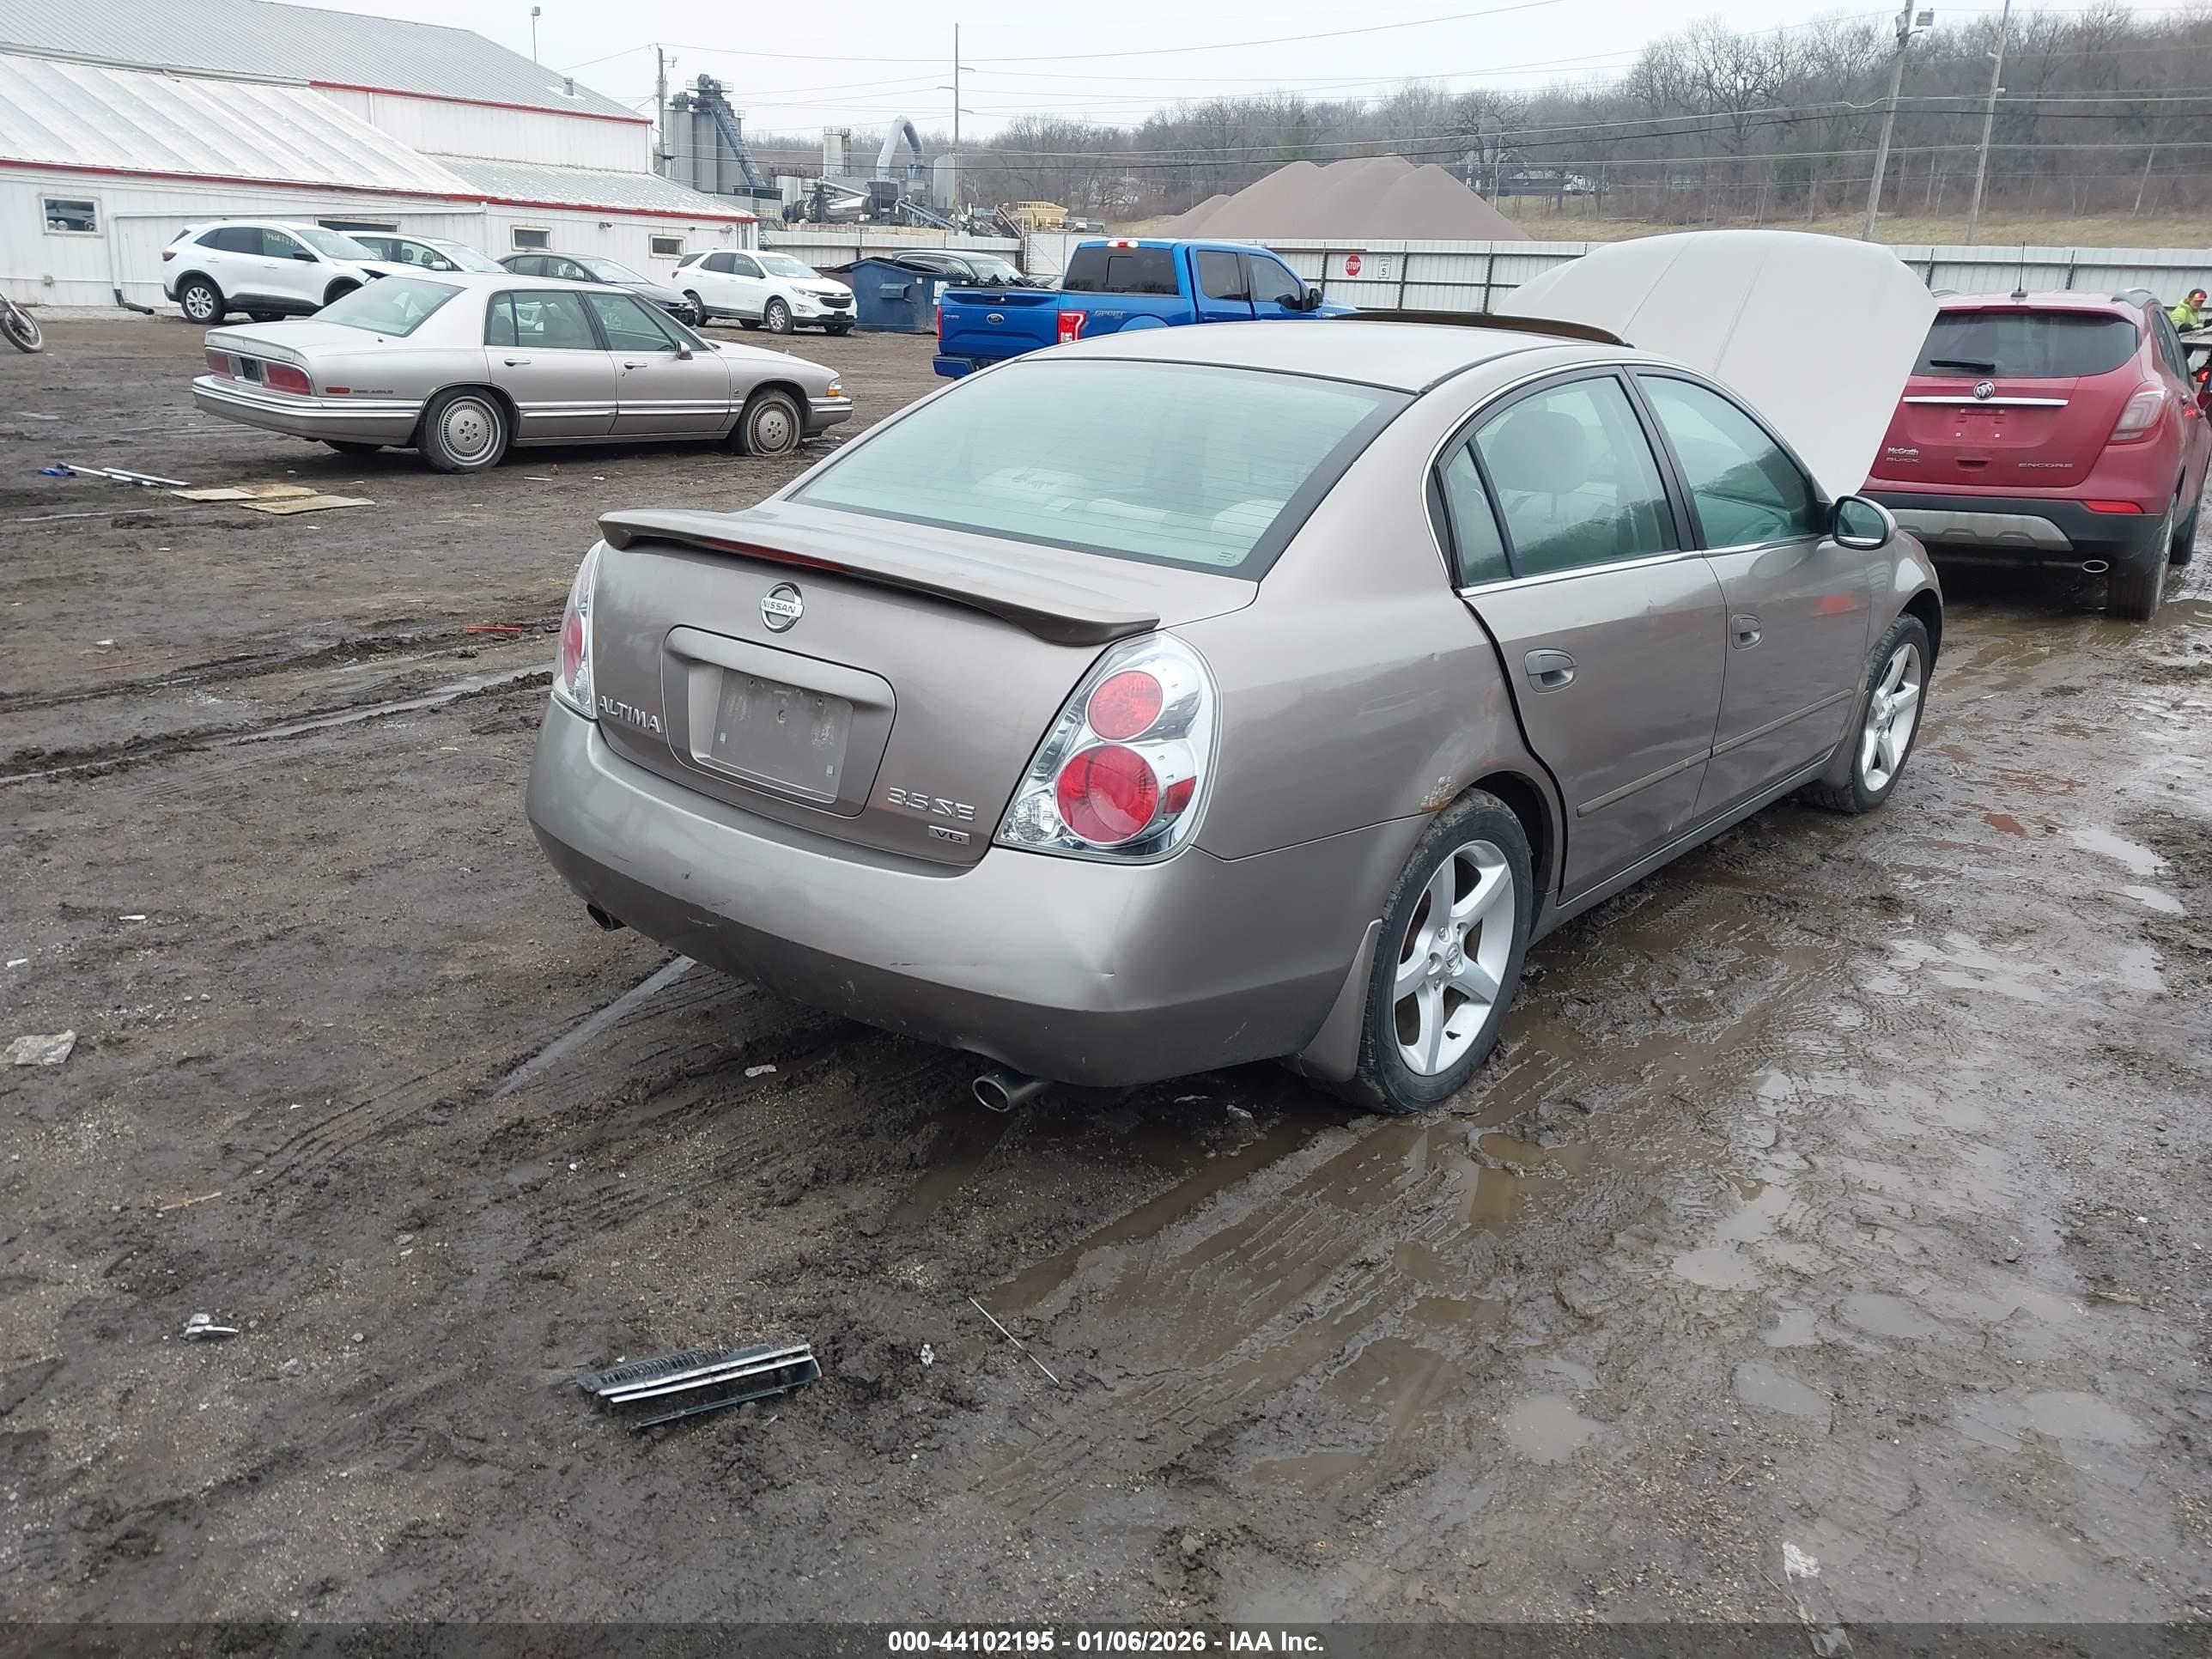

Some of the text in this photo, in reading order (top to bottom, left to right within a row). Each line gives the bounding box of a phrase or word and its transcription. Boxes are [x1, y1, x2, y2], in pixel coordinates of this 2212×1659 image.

[1346, 261, 1361, 270] STOP
[1887, 447, 1919, 456] McGrath
[763, 599, 797, 614] NISSAN
[599, 695, 663, 734] ALTIMA
[933, 829, 963, 842] V6
